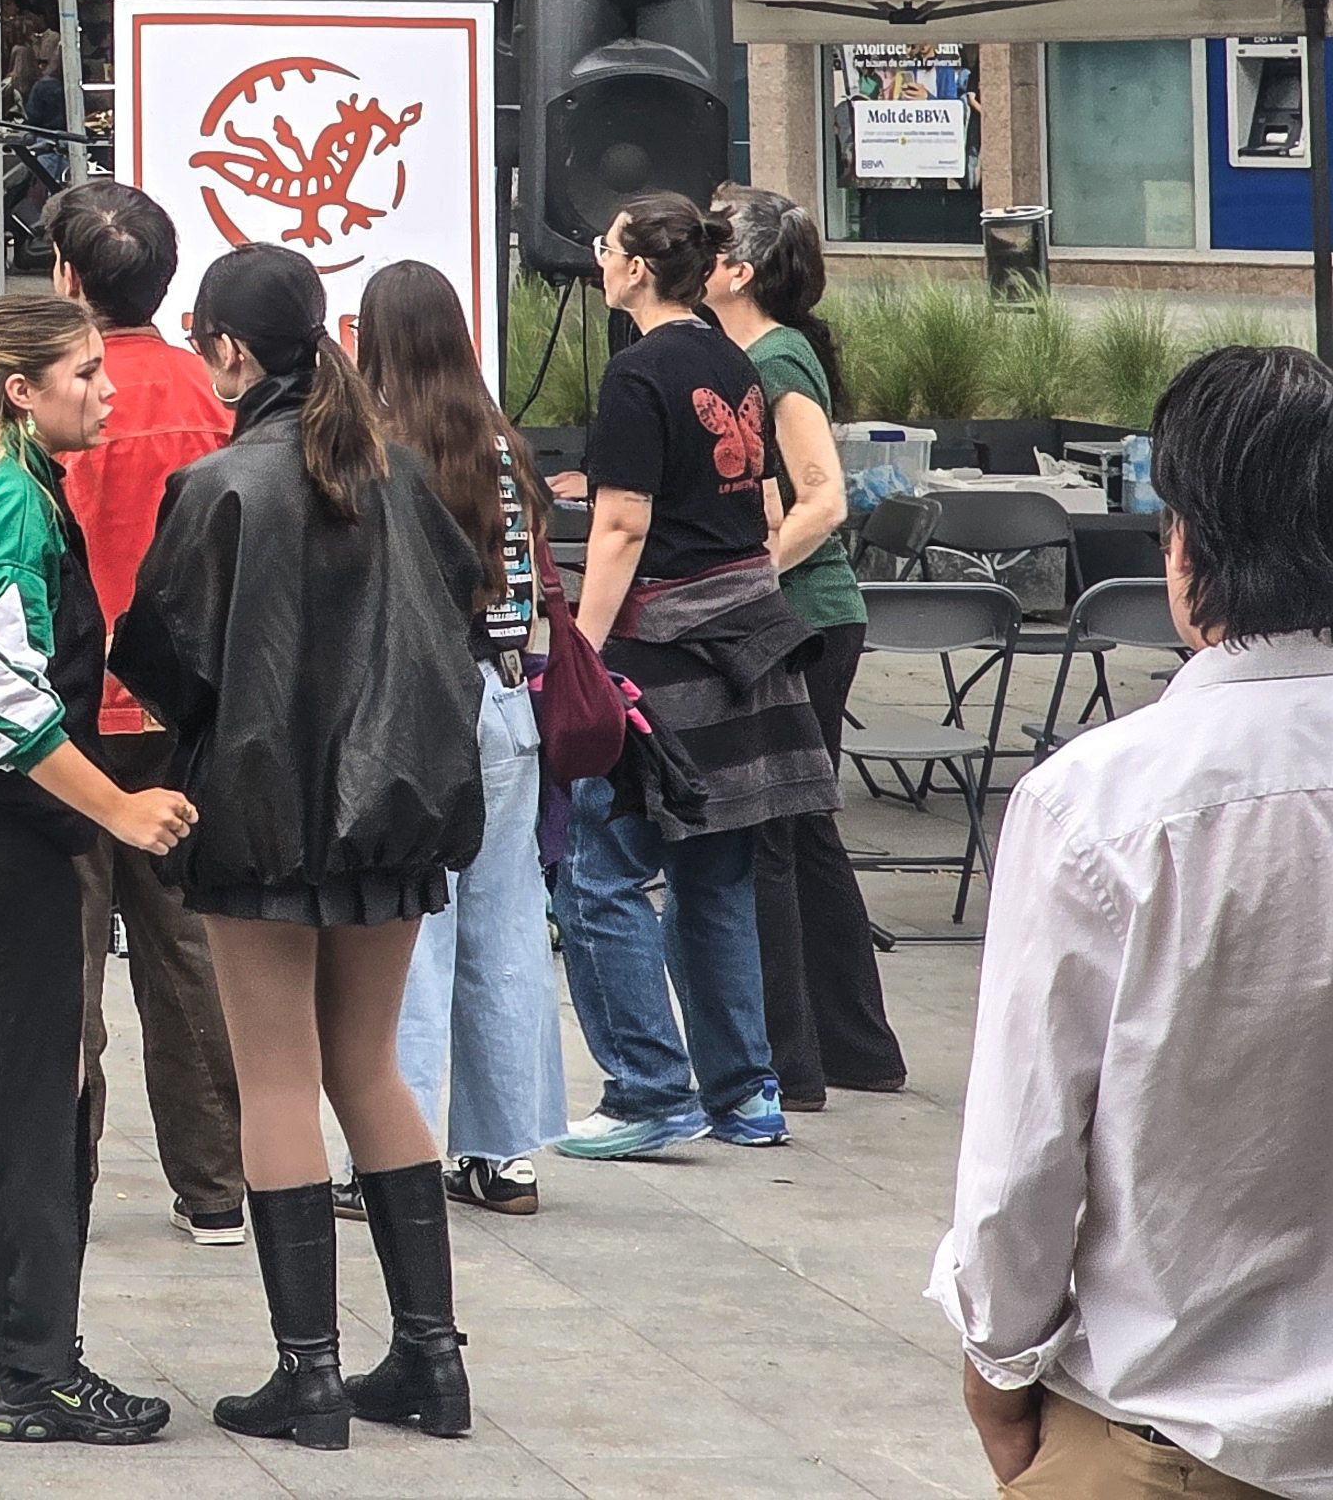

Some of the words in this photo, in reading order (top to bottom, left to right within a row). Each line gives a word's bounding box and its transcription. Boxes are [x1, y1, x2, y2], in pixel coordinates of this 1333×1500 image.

[867, 108, 896, 124] Molt
[898, 108, 913, 124] de
[915, 109, 951, 124] BBVA
[861, 159, 884, 170] BBVA
